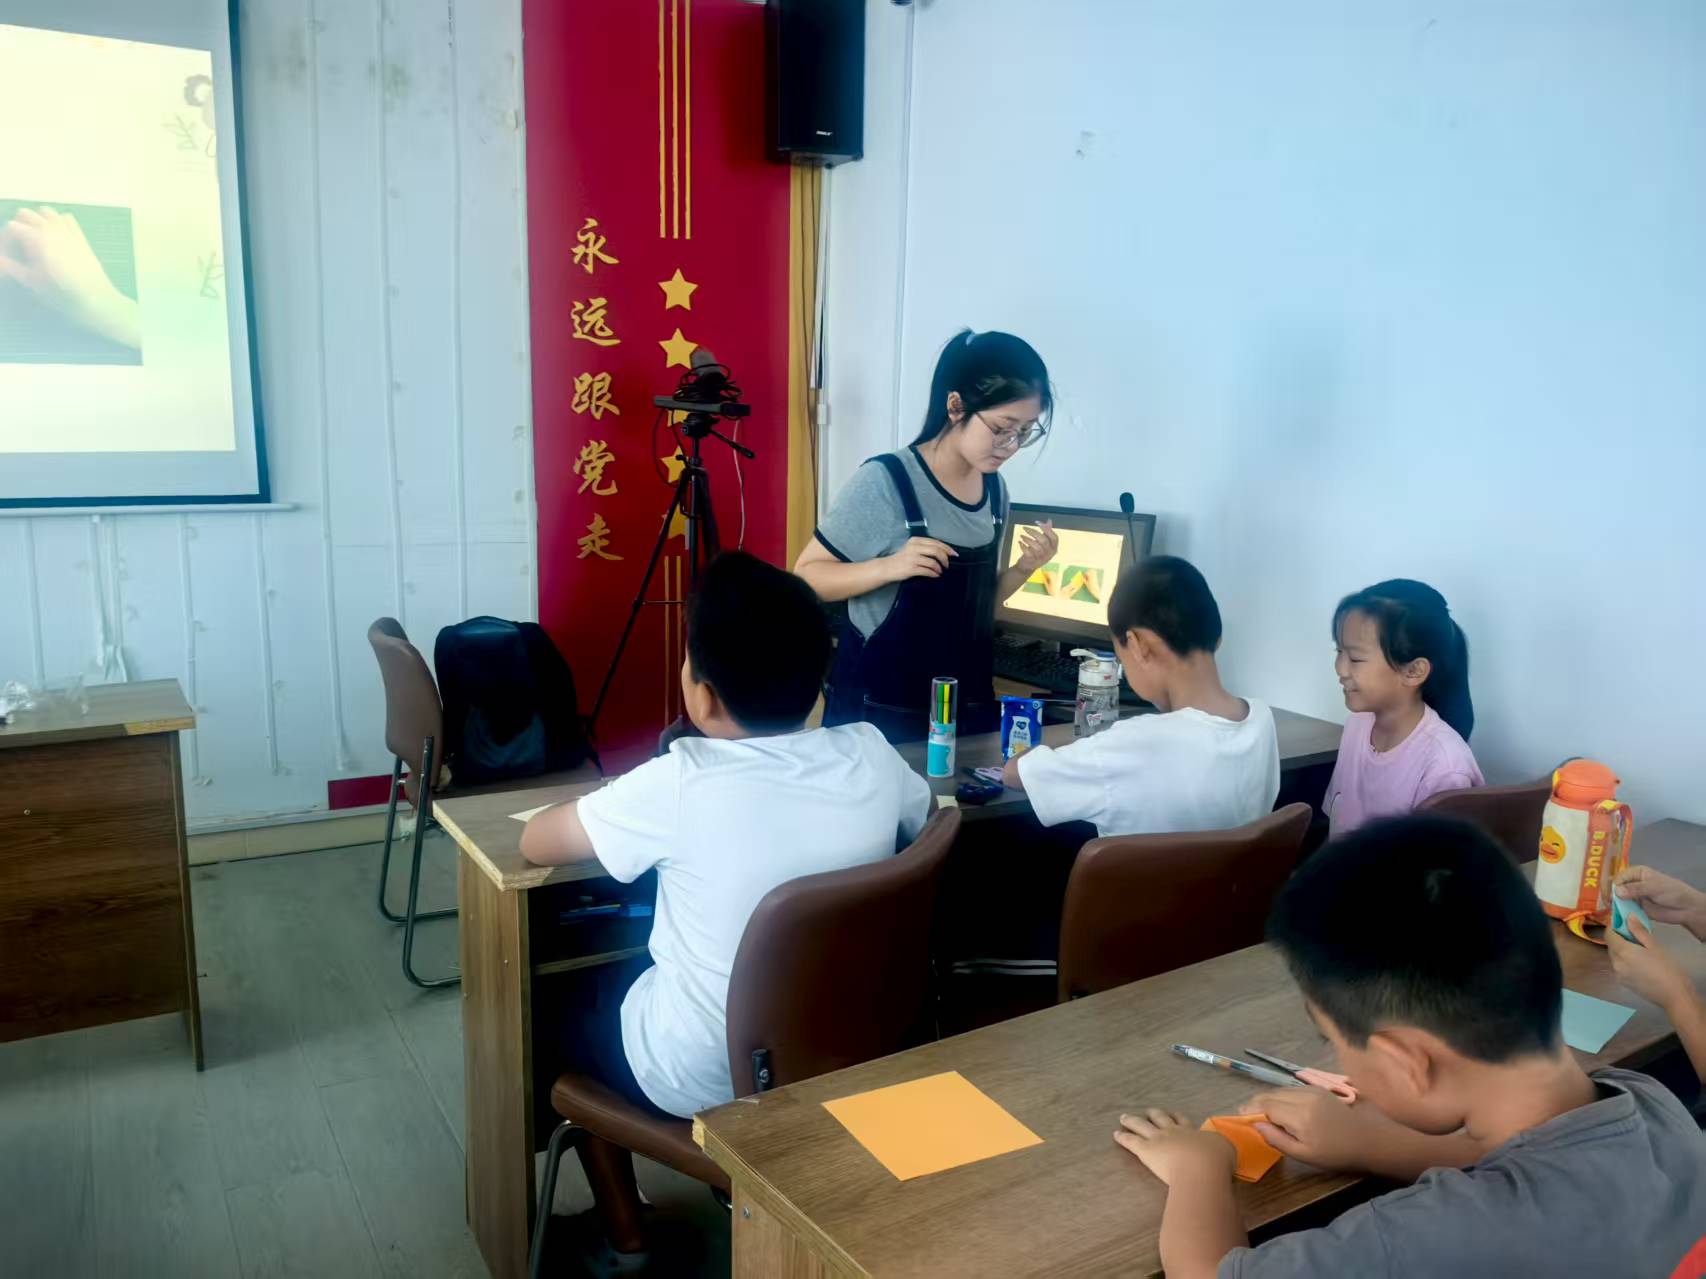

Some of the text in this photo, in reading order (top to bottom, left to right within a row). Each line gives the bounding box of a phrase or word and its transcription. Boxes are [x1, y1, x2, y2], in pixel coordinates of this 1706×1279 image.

[570, 217, 624, 561] 永远跟党走
